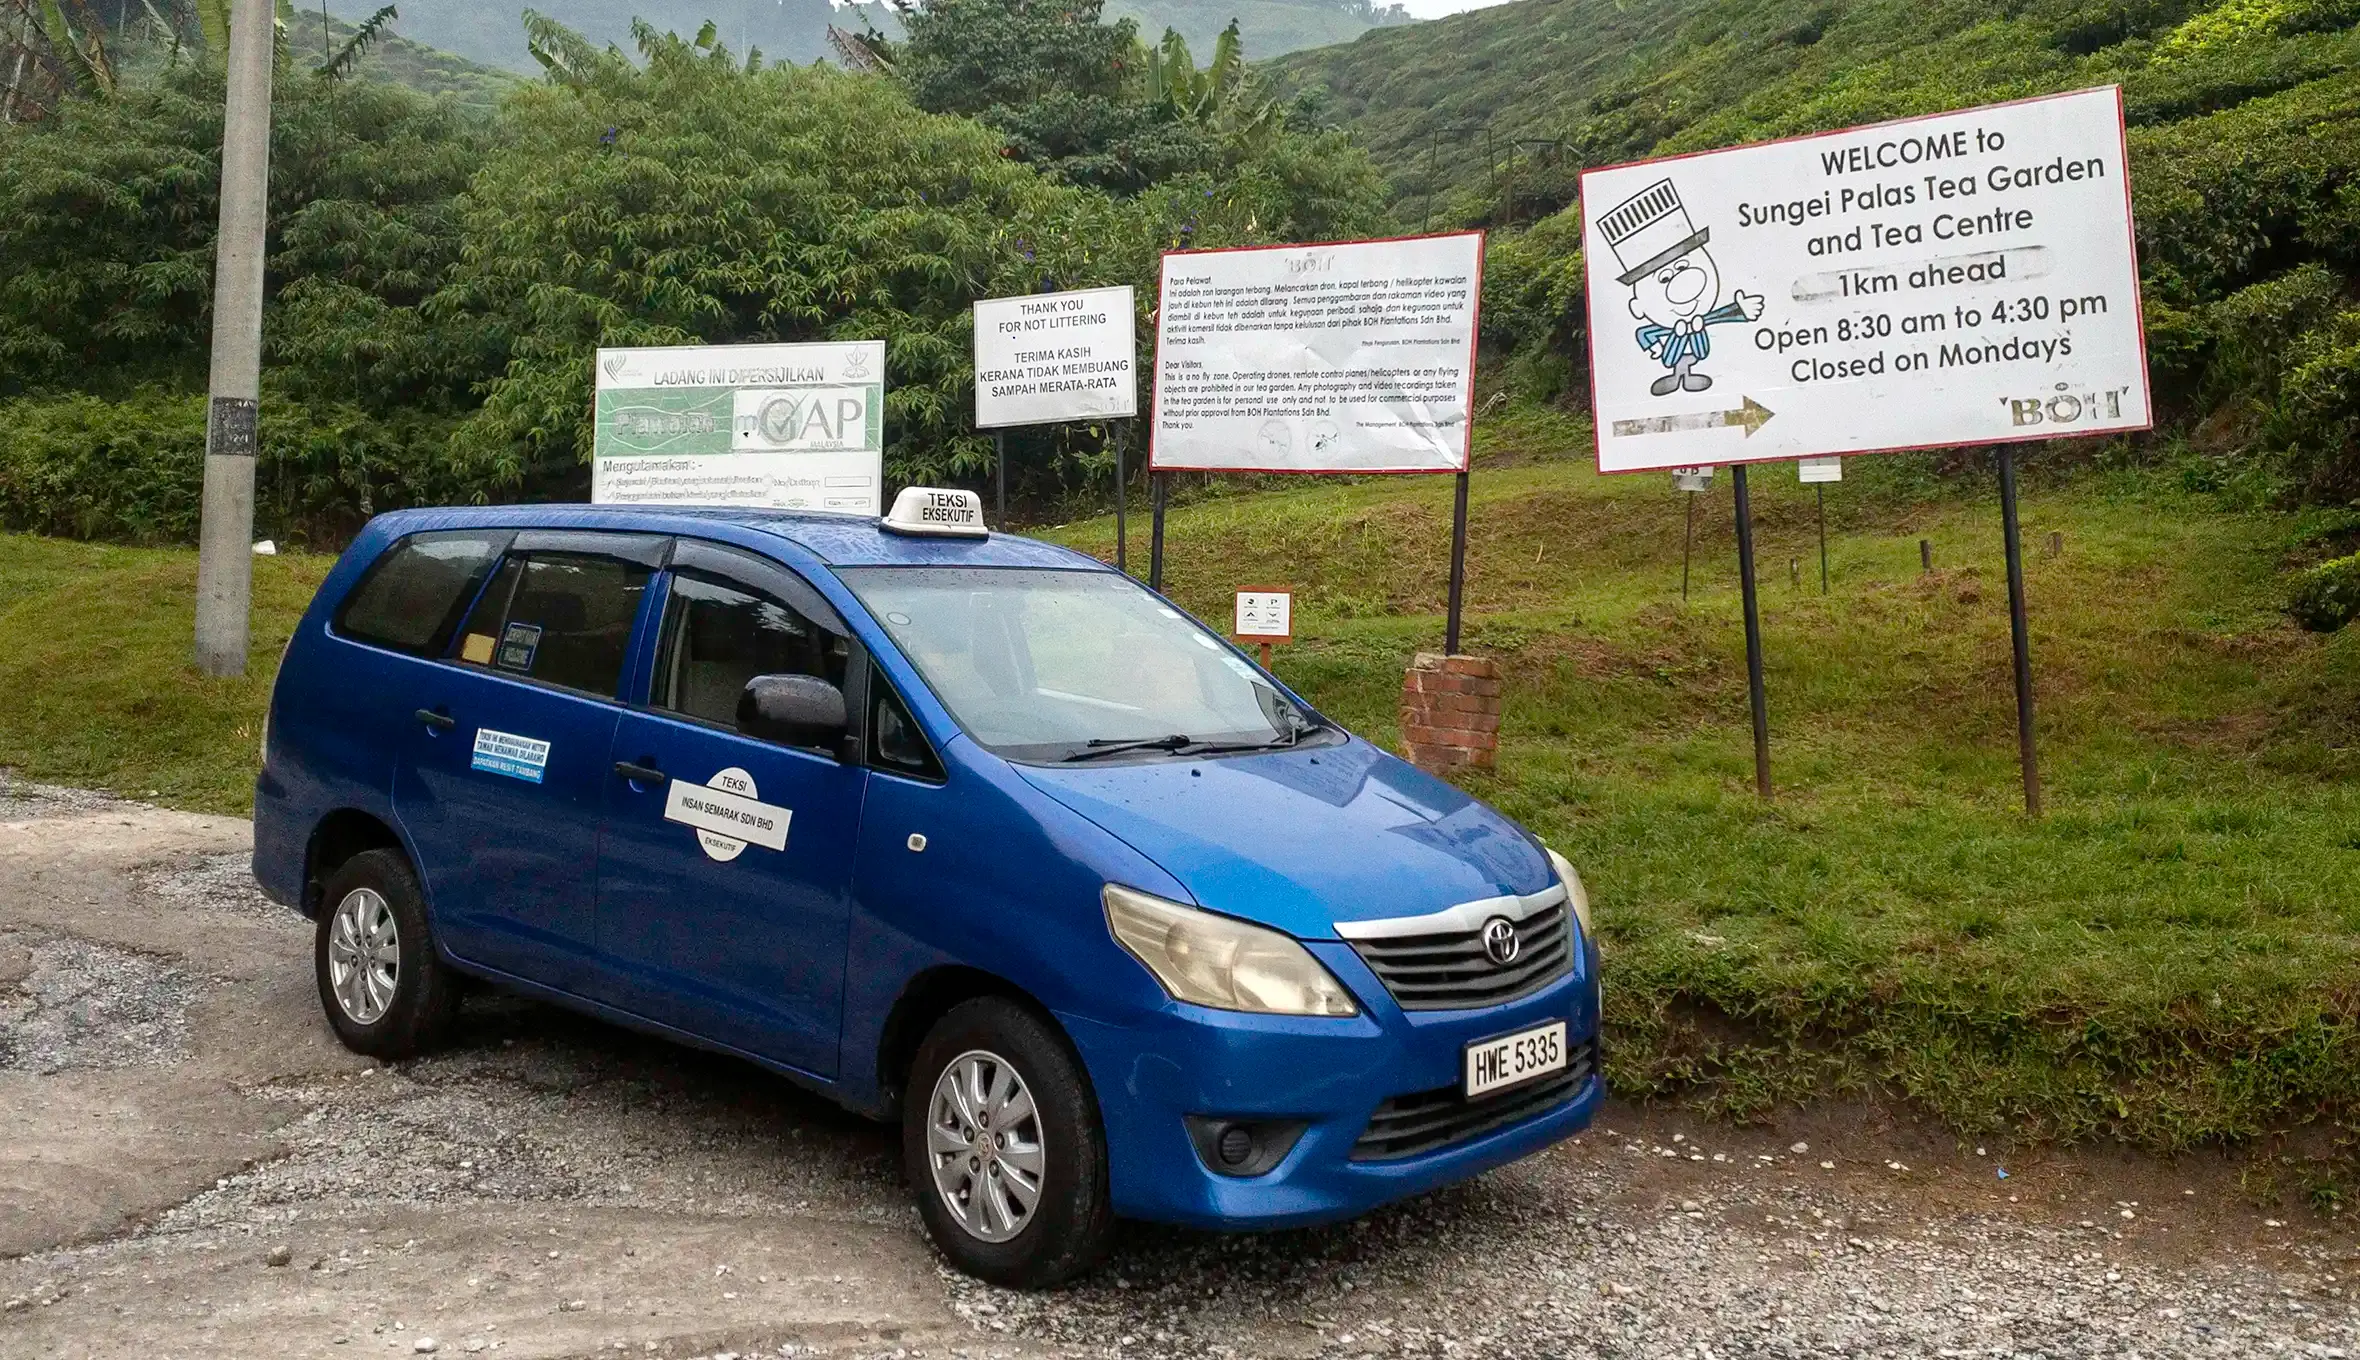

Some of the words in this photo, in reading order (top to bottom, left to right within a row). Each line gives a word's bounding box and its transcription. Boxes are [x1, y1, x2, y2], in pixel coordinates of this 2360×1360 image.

[1821, 131, 1968, 176] WELCOME
[1976, 128, 2006, 154] to
[1738, 195, 1832, 229] Sungei
[1841, 182, 1916, 215] Palas
[1924, 176, 1977, 200] Tea
[1987, 157, 2105, 193] Garden
[1807, 226, 1863, 257] and
[1870, 223, 1923, 248] Tea
[1933, 208, 2034, 242] Centre
[1838, 272, 1898, 298] 1km
[1908, 256, 2006, 289] ahead
[1178, 289, 1200, 297] adalah
[1215, 288, 1244, 296] larangan
[1274, 284, 1318, 292] Melancarkan
[1339, 281, 1358, 290] kapal
[1361, 279, 1388, 288] terbang
[1396, 277, 1432, 286] helikopter
[1435, 276, 1466, 284] kawalan
[1021, 302, 1058, 315] THANK
[1061, 300, 1083, 311] YOU
[1168, 302, 1182, 311] jauh
[1214, 300, 1223, 308] teh
[1293, 296, 1315, 304] Semua
[1318, 294, 1370, 304] penggambaran
[1388, 291, 1422, 299] rakaman
[1424, 290, 1444, 298] video
[1447, 289, 1466, 299] yang
[1168, 312, 1191, 322] diambil
[1194, 312, 1200, 320] di
[1204, 312, 1224, 320] kebun
[1242, 311, 1264, 319] adalah
[1268, 309, 1286, 317] untuk
[1290, 308, 1323, 318] kegunaan
[1327, 305, 1355, 316] peribadi
[1359, 304, 1382, 314] sahaja
[1386, 304, 1400, 312] dan
[1403, 303, 1440, 313] kegunaan
[1443, 302, 1463, 310] untuk
[999, 322, 1021, 333] FOR
[1025, 319, 1046, 331] NOT
[1050, 313, 1107, 328] LITTERING
[1167, 324, 1186, 333] aktiviti
[1189, 324, 1214, 332] komersil
[1216, 322, 1232, 331] tidak
[1234, 322, 1272, 331] dibenarkan
[1274, 322, 1293, 331] tanpa
[1295, 320, 1325, 328] kelulusan
[1327, 318, 1340, 327] dari
[1342, 318, 1361, 329] pihak
[1364, 318, 1378, 326] BOH
[1381, 316, 1418, 325] Plantations
[1421, 316, 1434, 324] Sdn
[1754, 326, 1829, 356] Open
[1837, 314, 1893, 343] 8:30
[1901, 312, 1946, 333] am
[1954, 305, 1983, 328] to
[1991, 296, 2049, 324] 4:30
[2060, 293, 2108, 324] pm
[1166, 337, 1186, 345] Terima
[1015, 351, 1055, 363] TERIMA
[1058, 347, 1091, 359] KASIH
[1790, 348, 1885, 384] Closed
[1894, 348, 1929, 372] on
[1938, 334, 2073, 370] Mondays
[980, 369, 1024, 382] KERANA
[1028, 366, 1059, 378] TIDAK
[1063, 360, 1128, 375] MEMBUANG
[1165, 361, 1179, 369] Dear
[1233, 372, 1265, 380] Operating
[1294, 370, 1318, 378] remote
[1321, 370, 1343, 378] control
[1423, 369, 1436, 378] any
[1439, 367, 1458, 377] flying
[654, 370, 705, 385] LADANG
[709, 369, 725, 383] INI
[992, 384, 1036, 397] SAMPAH
[1040, 378, 1117, 393] MERATA-RATA
[1164, 385, 1186, 394] objects
[1201, 384, 1233, 393] prohibited
[1235, 384, 1240, 392] in
[1298, 384, 1311, 392] Any
[1314, 382, 1356, 392] photography
[1374, 381, 1392, 389] video
[1394, 381, 1433, 391] recordings
[1435, 380, 1456, 388] taken
[1193, 396, 1215, 406] garden
[1217, 396, 1221, 404] is
[1223, 396, 1231, 404] for
[1235, 396, 1263, 405] personal
[1282, 396, 1296, 405] only
[1299, 395, 1312, 403] and
[1368, 394, 1377, 402] for
[1379, 394, 1421, 402] commercial
[1423, 394, 1456, 403] purposes
[1186, 409, 1199, 418] prior
[1201, 408, 1229, 418] approval
[1231, 408, 1246, 416] from
[1248, 408, 1262, 416] BOH
[1263, 408, 1300, 416] Plantations
[1302, 408, 1314, 416] Sdn
[928, 493, 967, 507] TEKSI
[923, 508, 974, 522] EKSEKUTIF
[722, 776, 747, 791] TEKSI
[682, 796, 703, 811] INSAN
[704, 803, 740, 820] SEMARAK
[740, 813, 756, 826] SDN
[757, 818, 774, 831] BHD
[705, 837, 736, 852] EKSEKUTIF
[1476, 1045, 1509, 1086] HWE
[1516, 1032, 1558, 1073] 5335
